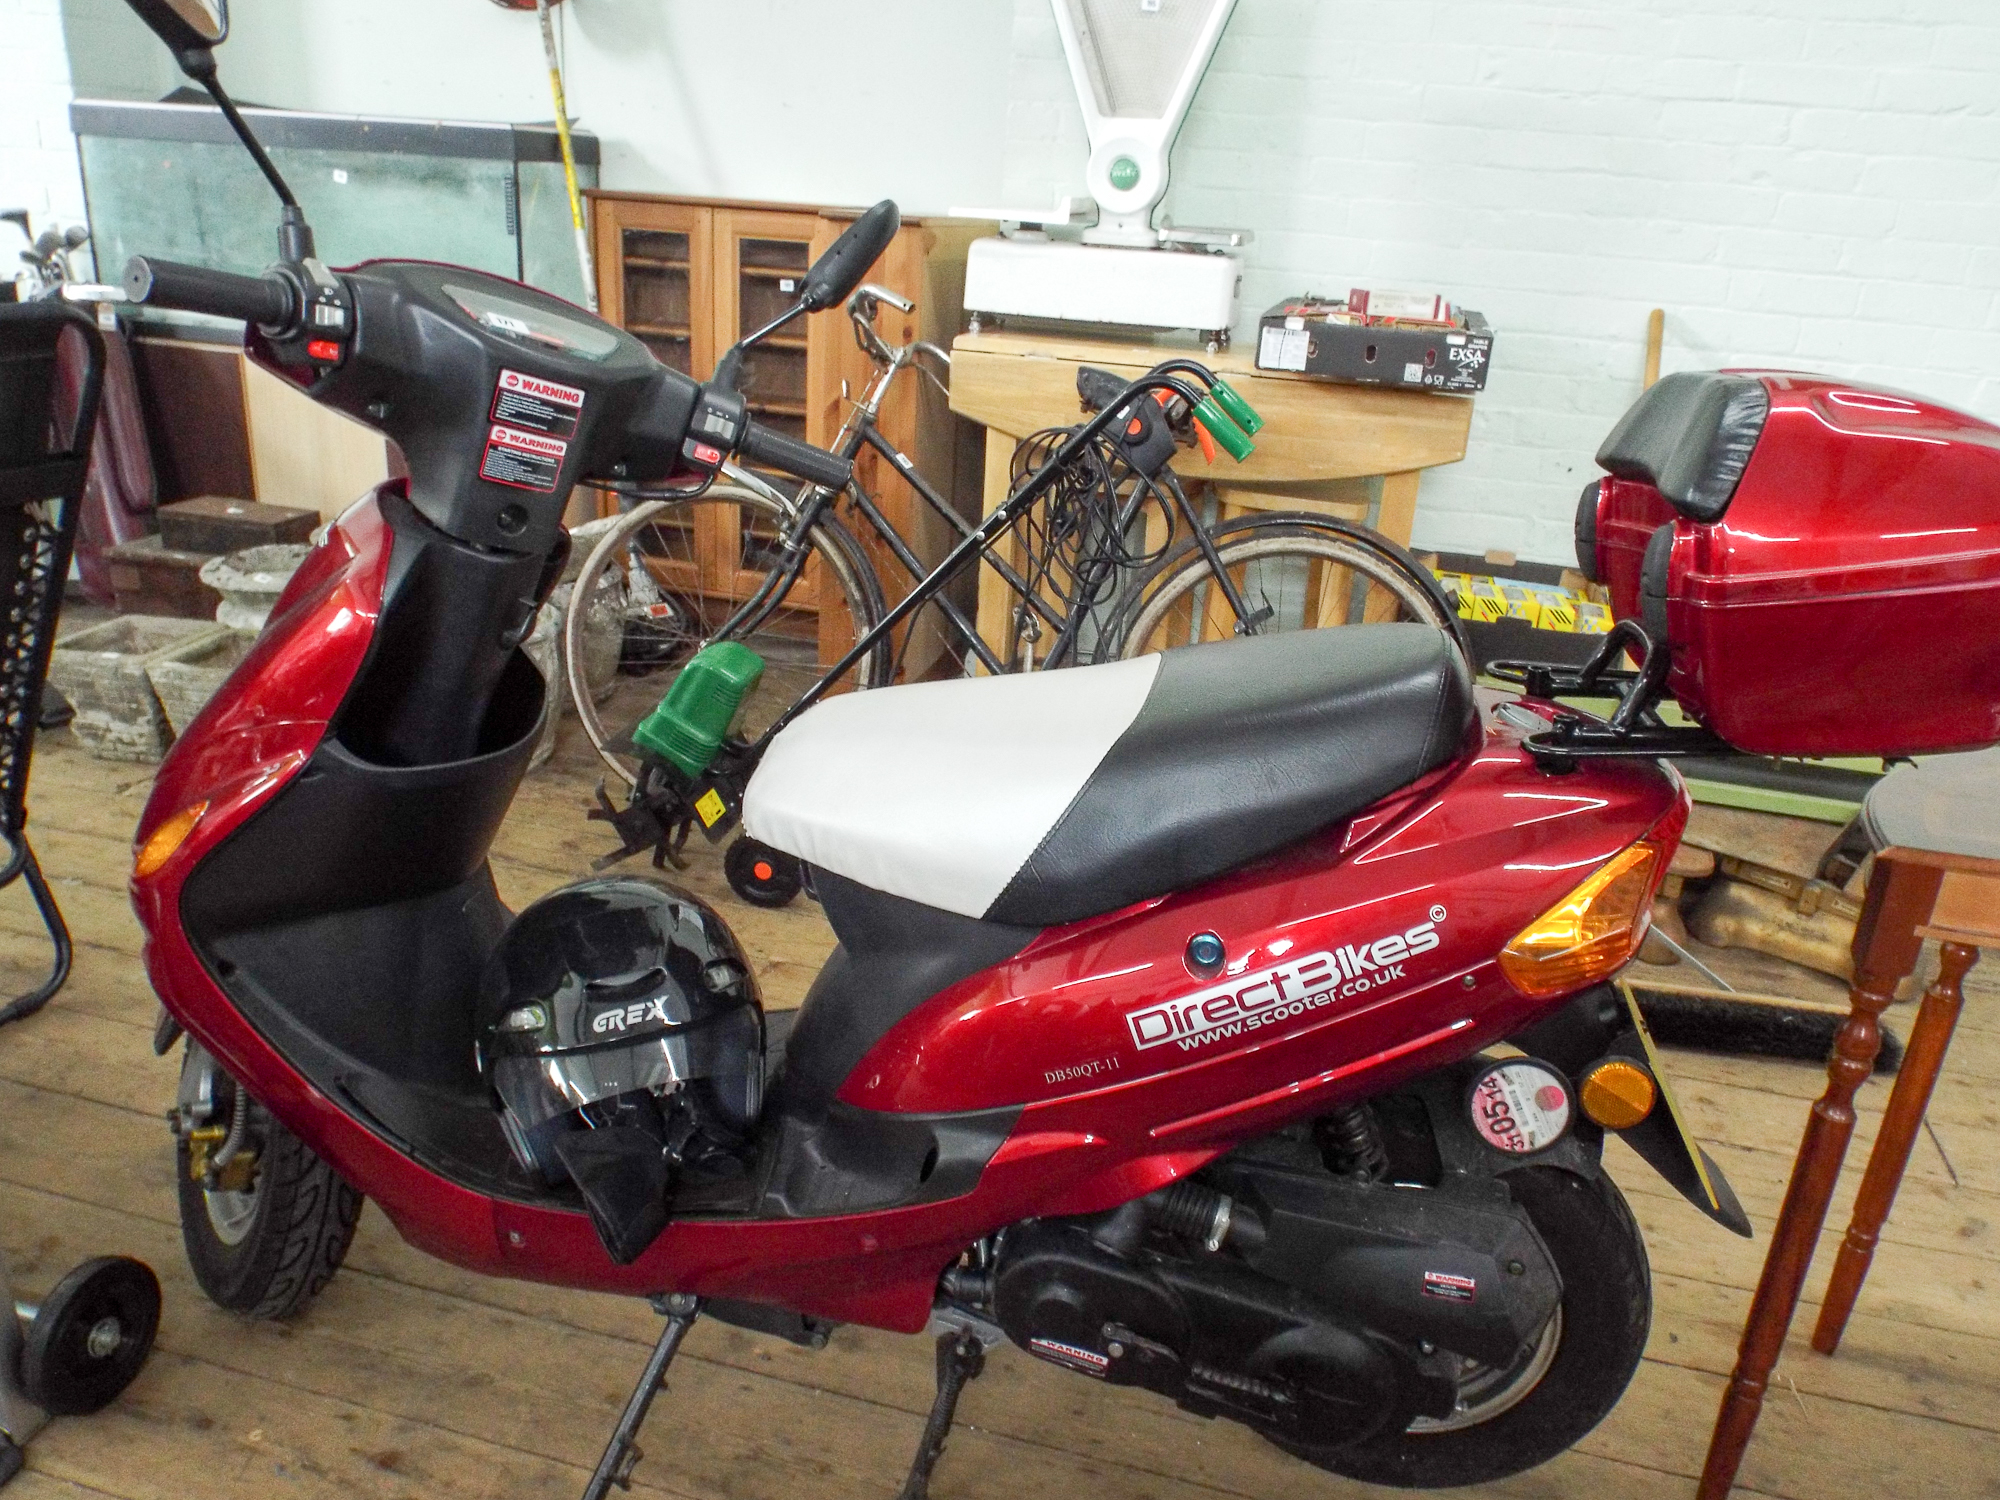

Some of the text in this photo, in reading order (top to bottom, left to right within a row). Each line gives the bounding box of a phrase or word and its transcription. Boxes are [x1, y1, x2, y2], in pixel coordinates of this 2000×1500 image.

[1449, 347, 1484, 363] EXSA
[522, 379, 580, 403] WARNING
[509, 434, 564, 453] WARNING
[593, 995, 670, 1033] GREX
[1177, 964, 1406, 1051] www.scooter.co.uk
[1044, 1057, 1120, 1084] DB50QT-11
[1480, 1077, 1502, 1100] 14
[1482, 1101, 1516, 1134] 05
[1436, 1275, 1472, 1285] WARNING
[1047, 1341, 1104, 1363] WARNING
